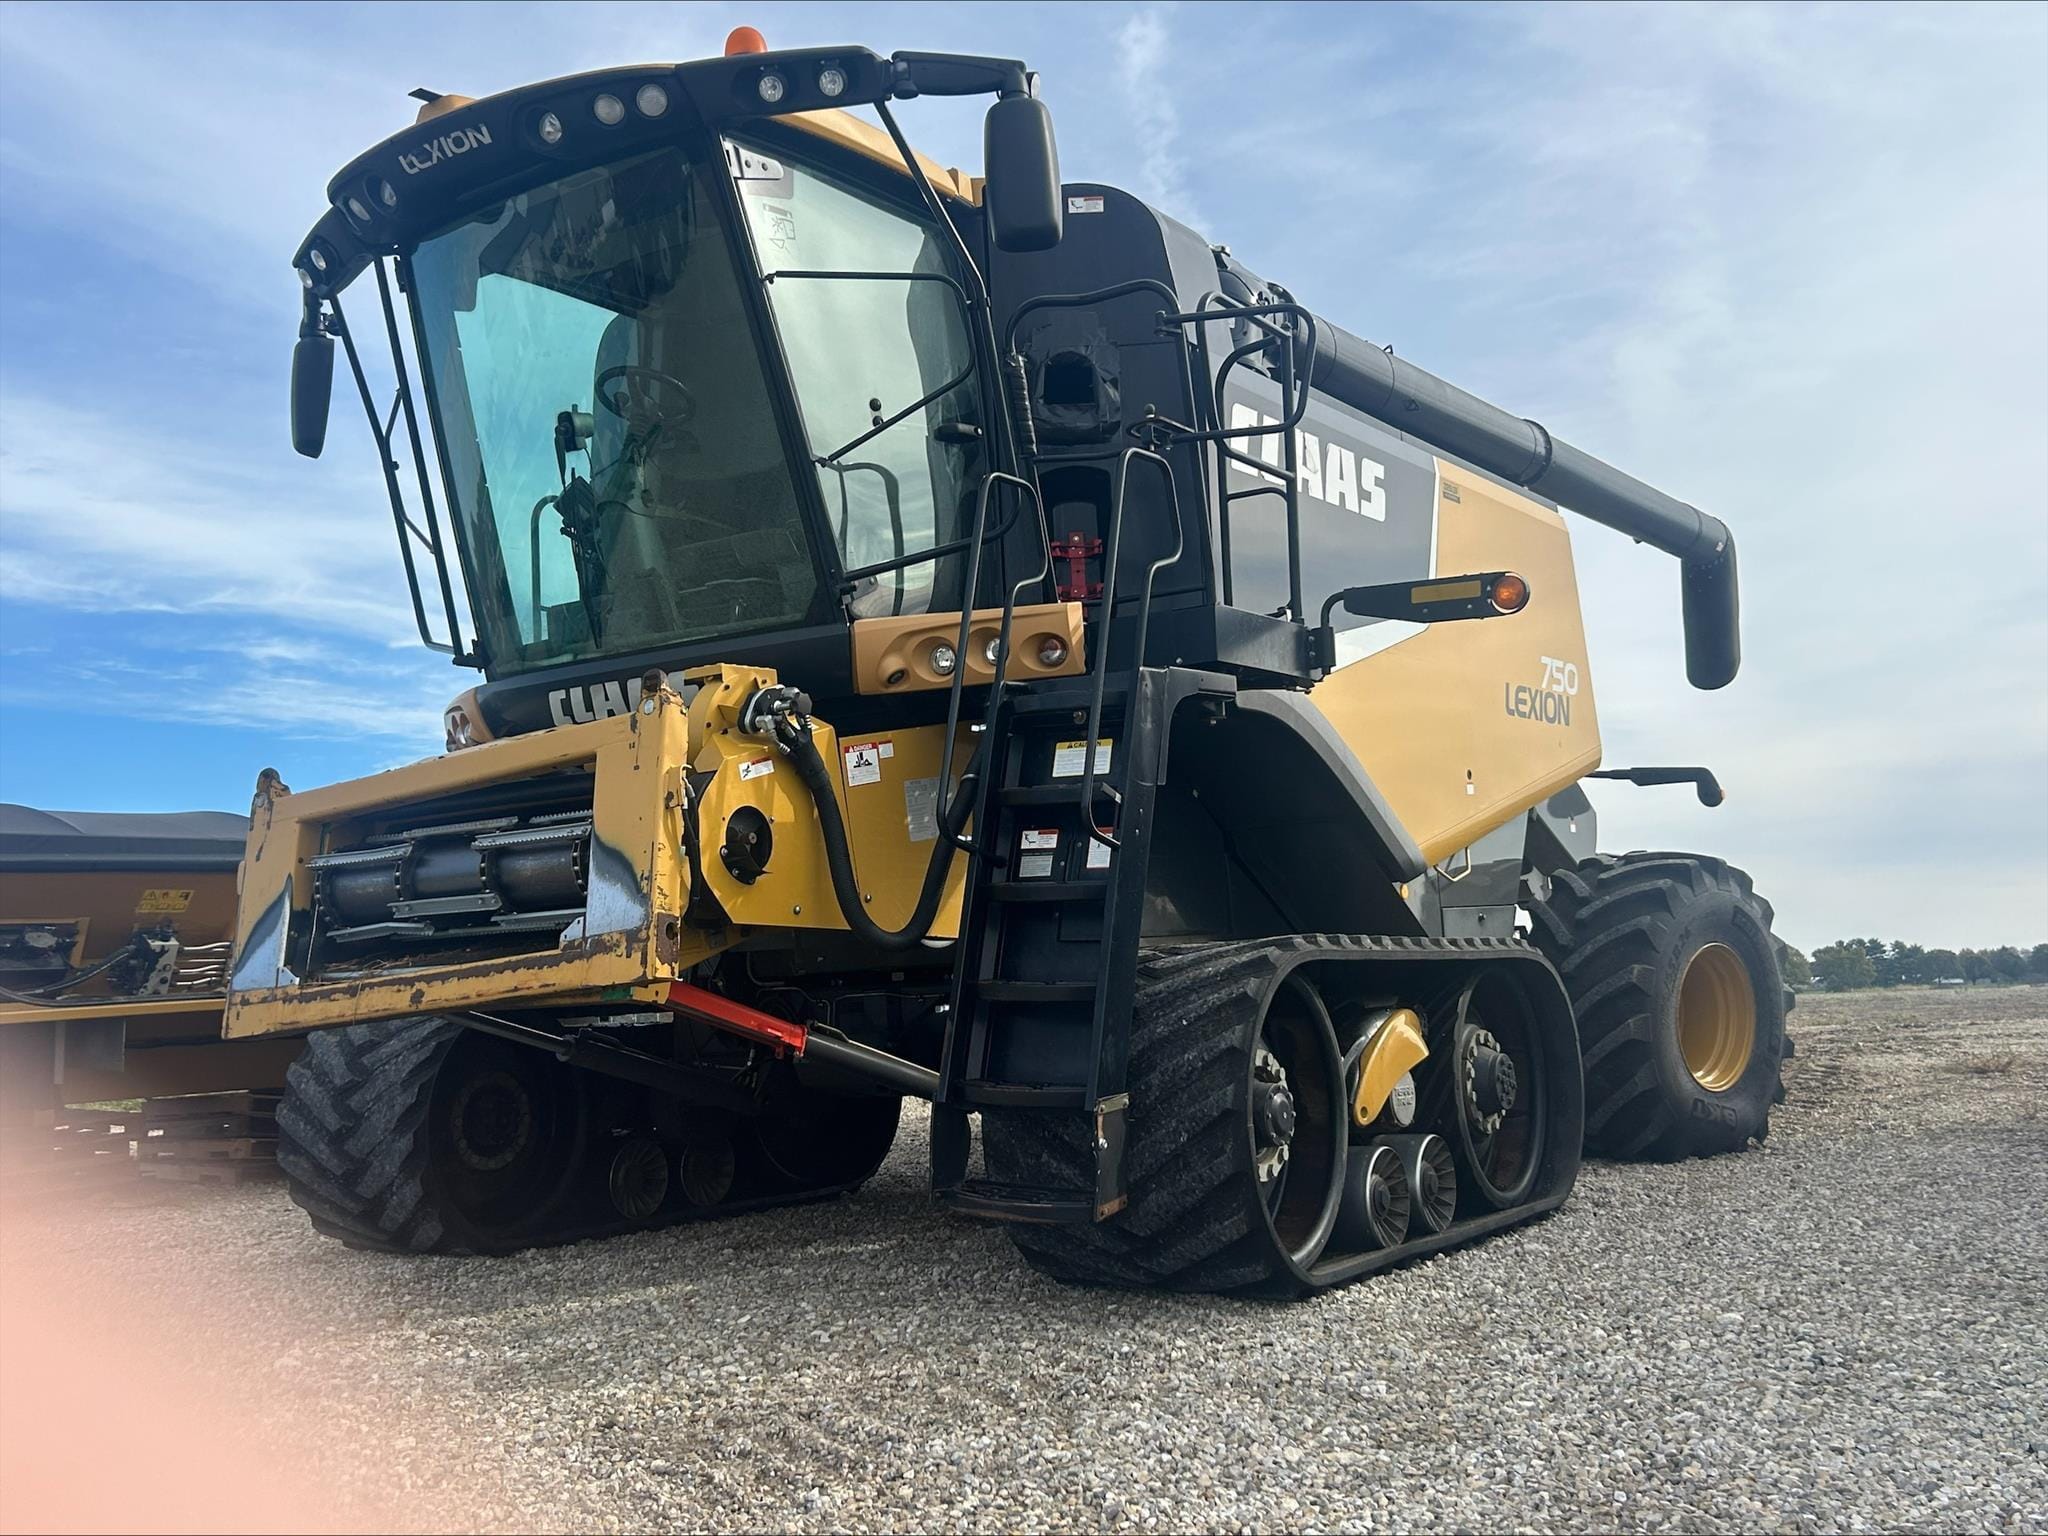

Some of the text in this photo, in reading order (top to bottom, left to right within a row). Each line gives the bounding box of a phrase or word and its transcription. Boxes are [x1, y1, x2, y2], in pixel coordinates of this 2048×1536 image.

[398, 123, 492, 174] LEXION
[1231, 403, 1386, 522] CLAAS
[1541, 655, 1578, 696] 750
[1505, 682, 1570, 727] LEXION
